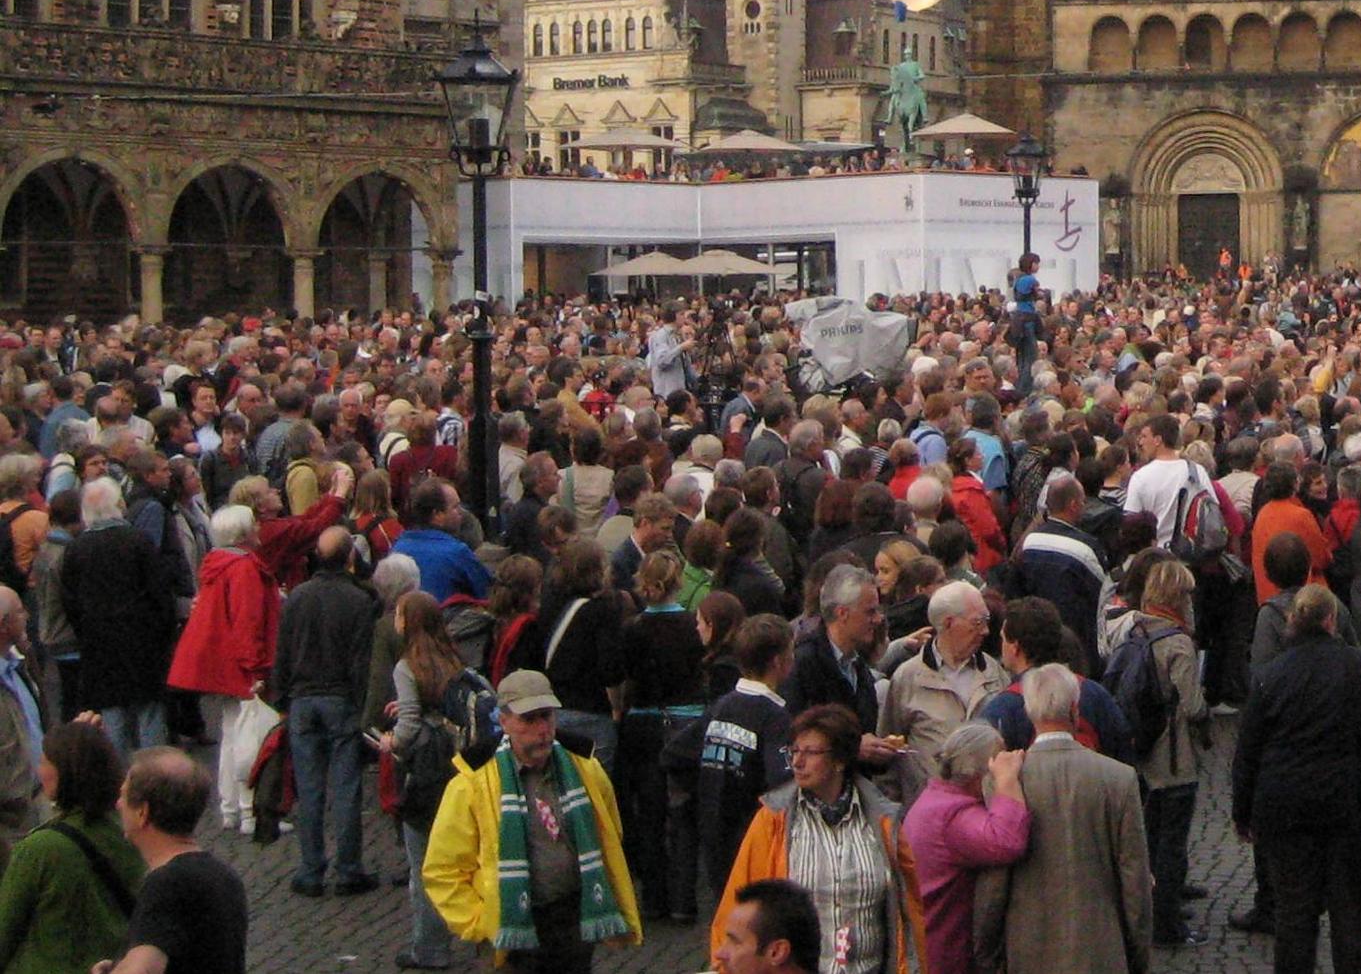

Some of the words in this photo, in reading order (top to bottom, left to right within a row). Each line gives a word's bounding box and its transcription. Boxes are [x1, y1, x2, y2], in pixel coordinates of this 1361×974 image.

[553, 77, 595, 90] Bremer
[598, 73, 629, 87] Bank
[820, 324, 864, 339] PHILIPS
